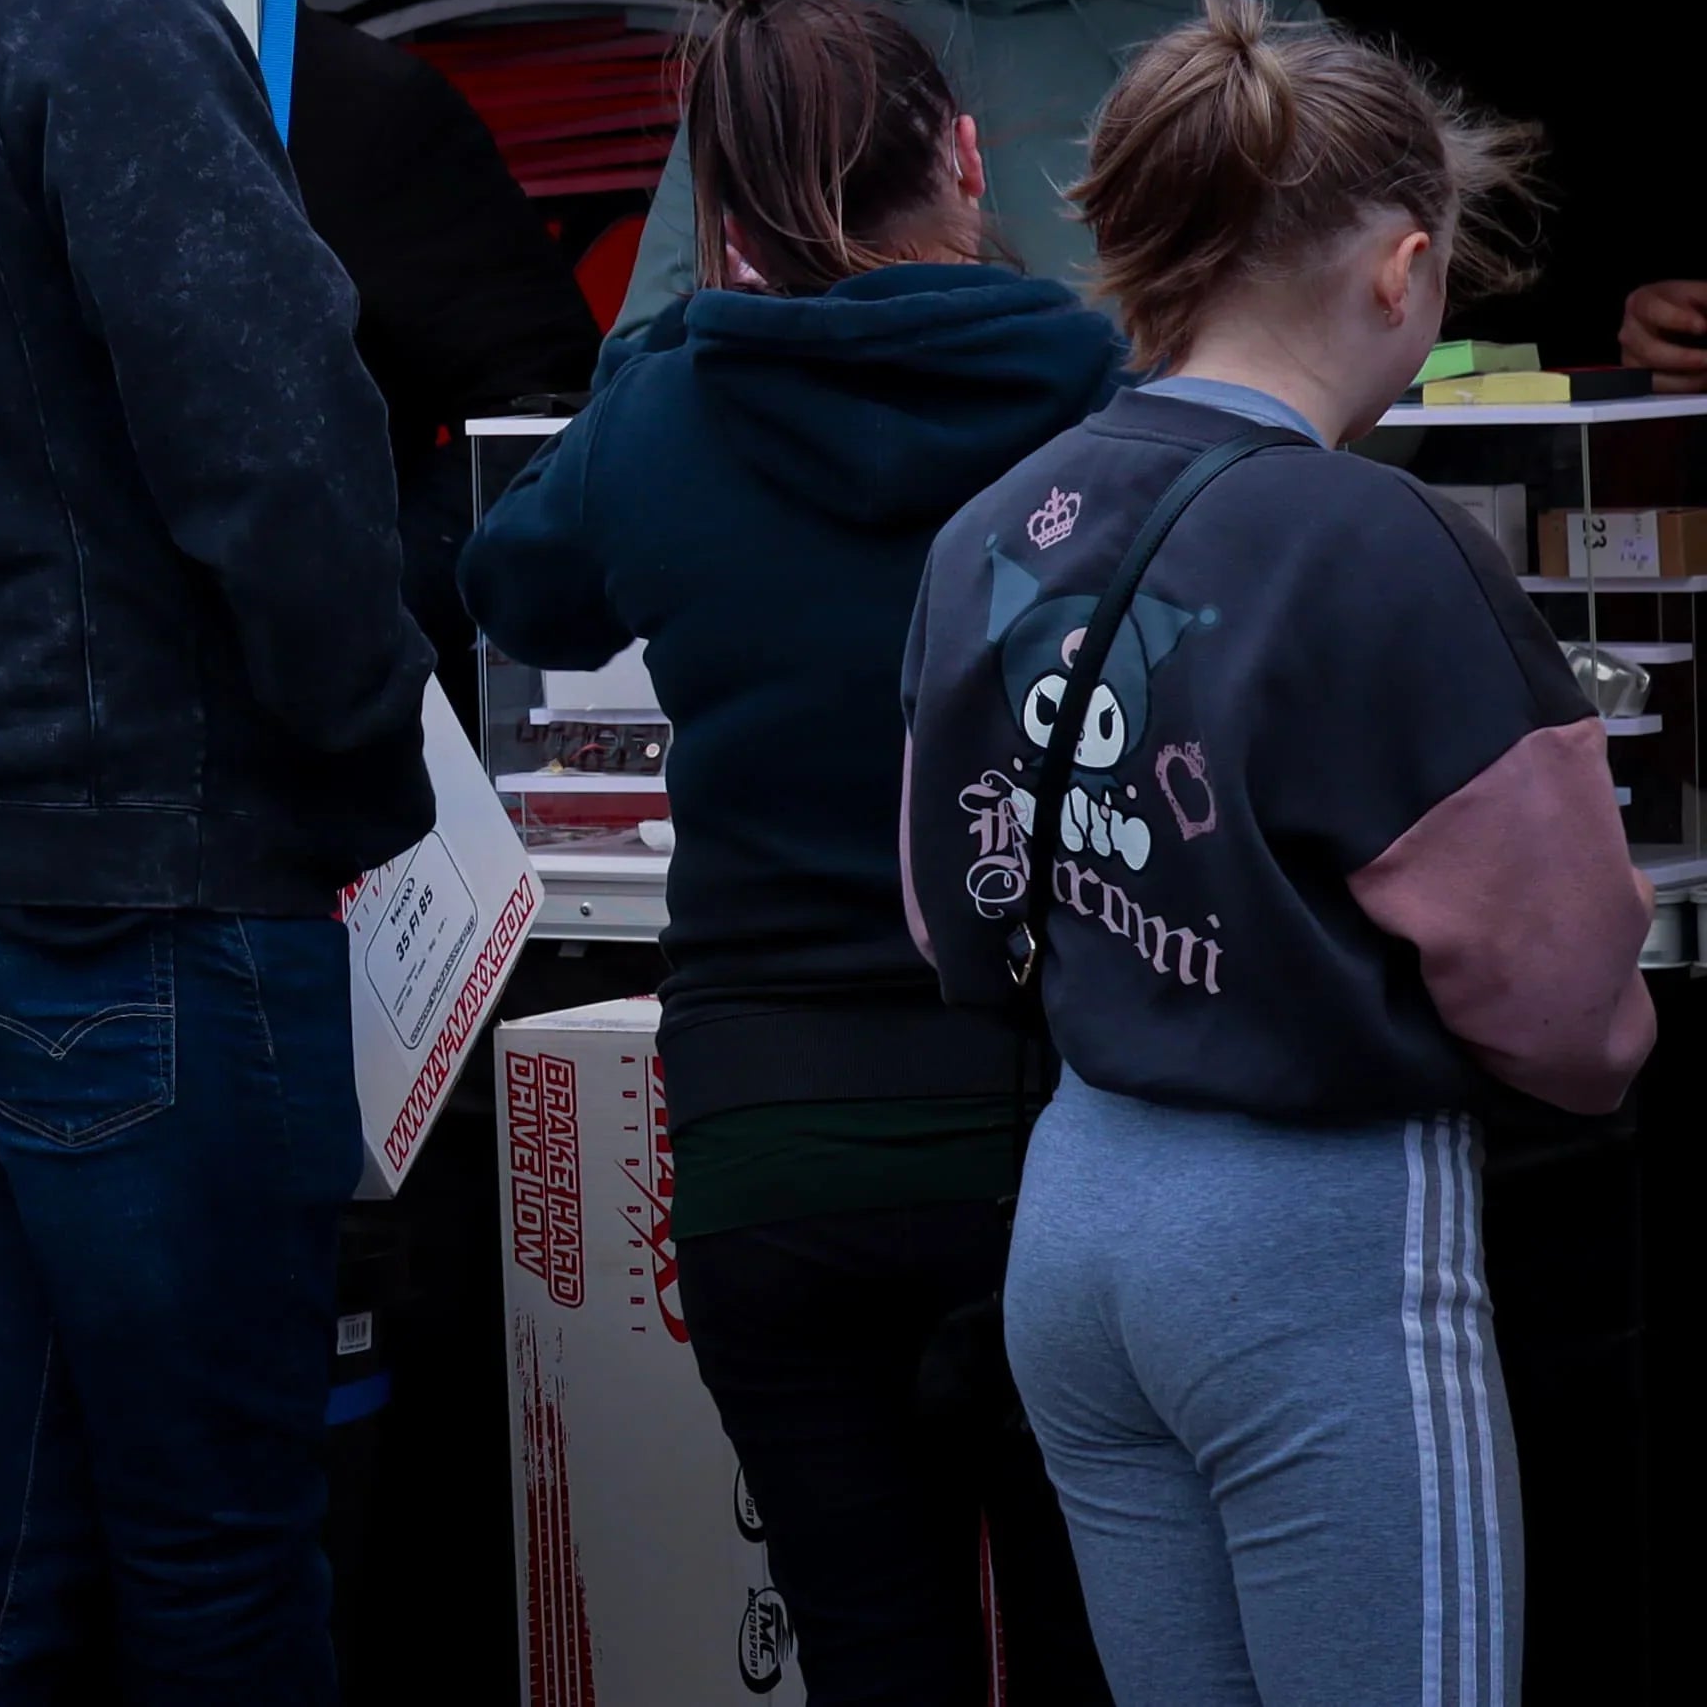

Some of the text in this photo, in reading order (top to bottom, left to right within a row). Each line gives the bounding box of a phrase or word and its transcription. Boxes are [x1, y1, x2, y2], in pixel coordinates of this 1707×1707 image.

[395, 933, 412, 963] 35
[419, 884, 434, 915] 85
[505, 1050, 544, 1178] DRIVE
[539, 1053, 577, 1195] BRAKE
[511, 1176, 548, 1283] LOW
[546, 1193, 585, 1310] HARD
[747, 1586, 759, 1676] MOTORSPORT
[757, 1602, 776, 1665] TMC
